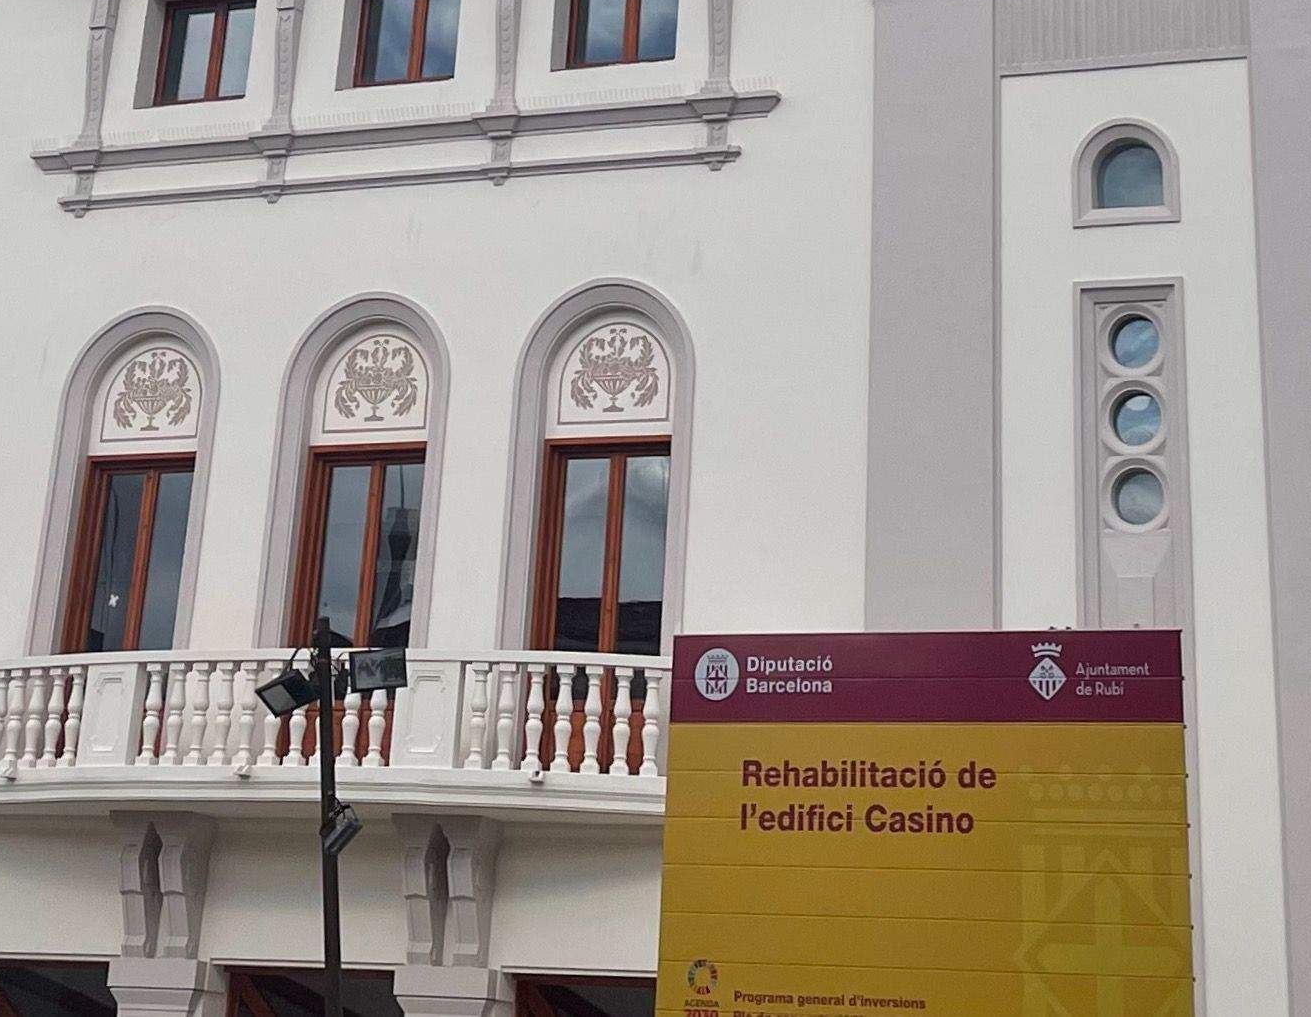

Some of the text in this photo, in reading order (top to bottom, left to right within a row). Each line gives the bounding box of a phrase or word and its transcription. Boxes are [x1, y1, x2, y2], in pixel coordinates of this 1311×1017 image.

[746, 655, 833, 676] Diputació
[1075, 662, 1150, 680] Ajuntament
[746, 677, 833, 693] Barcelona
[1075, 681, 1125, 696] de Rubí
[741, 760, 997, 789] Rehabilitació de
[740, 803, 974, 834] l’edifici Casino
[733, 990, 926, 1009] Programa general d'inversions
